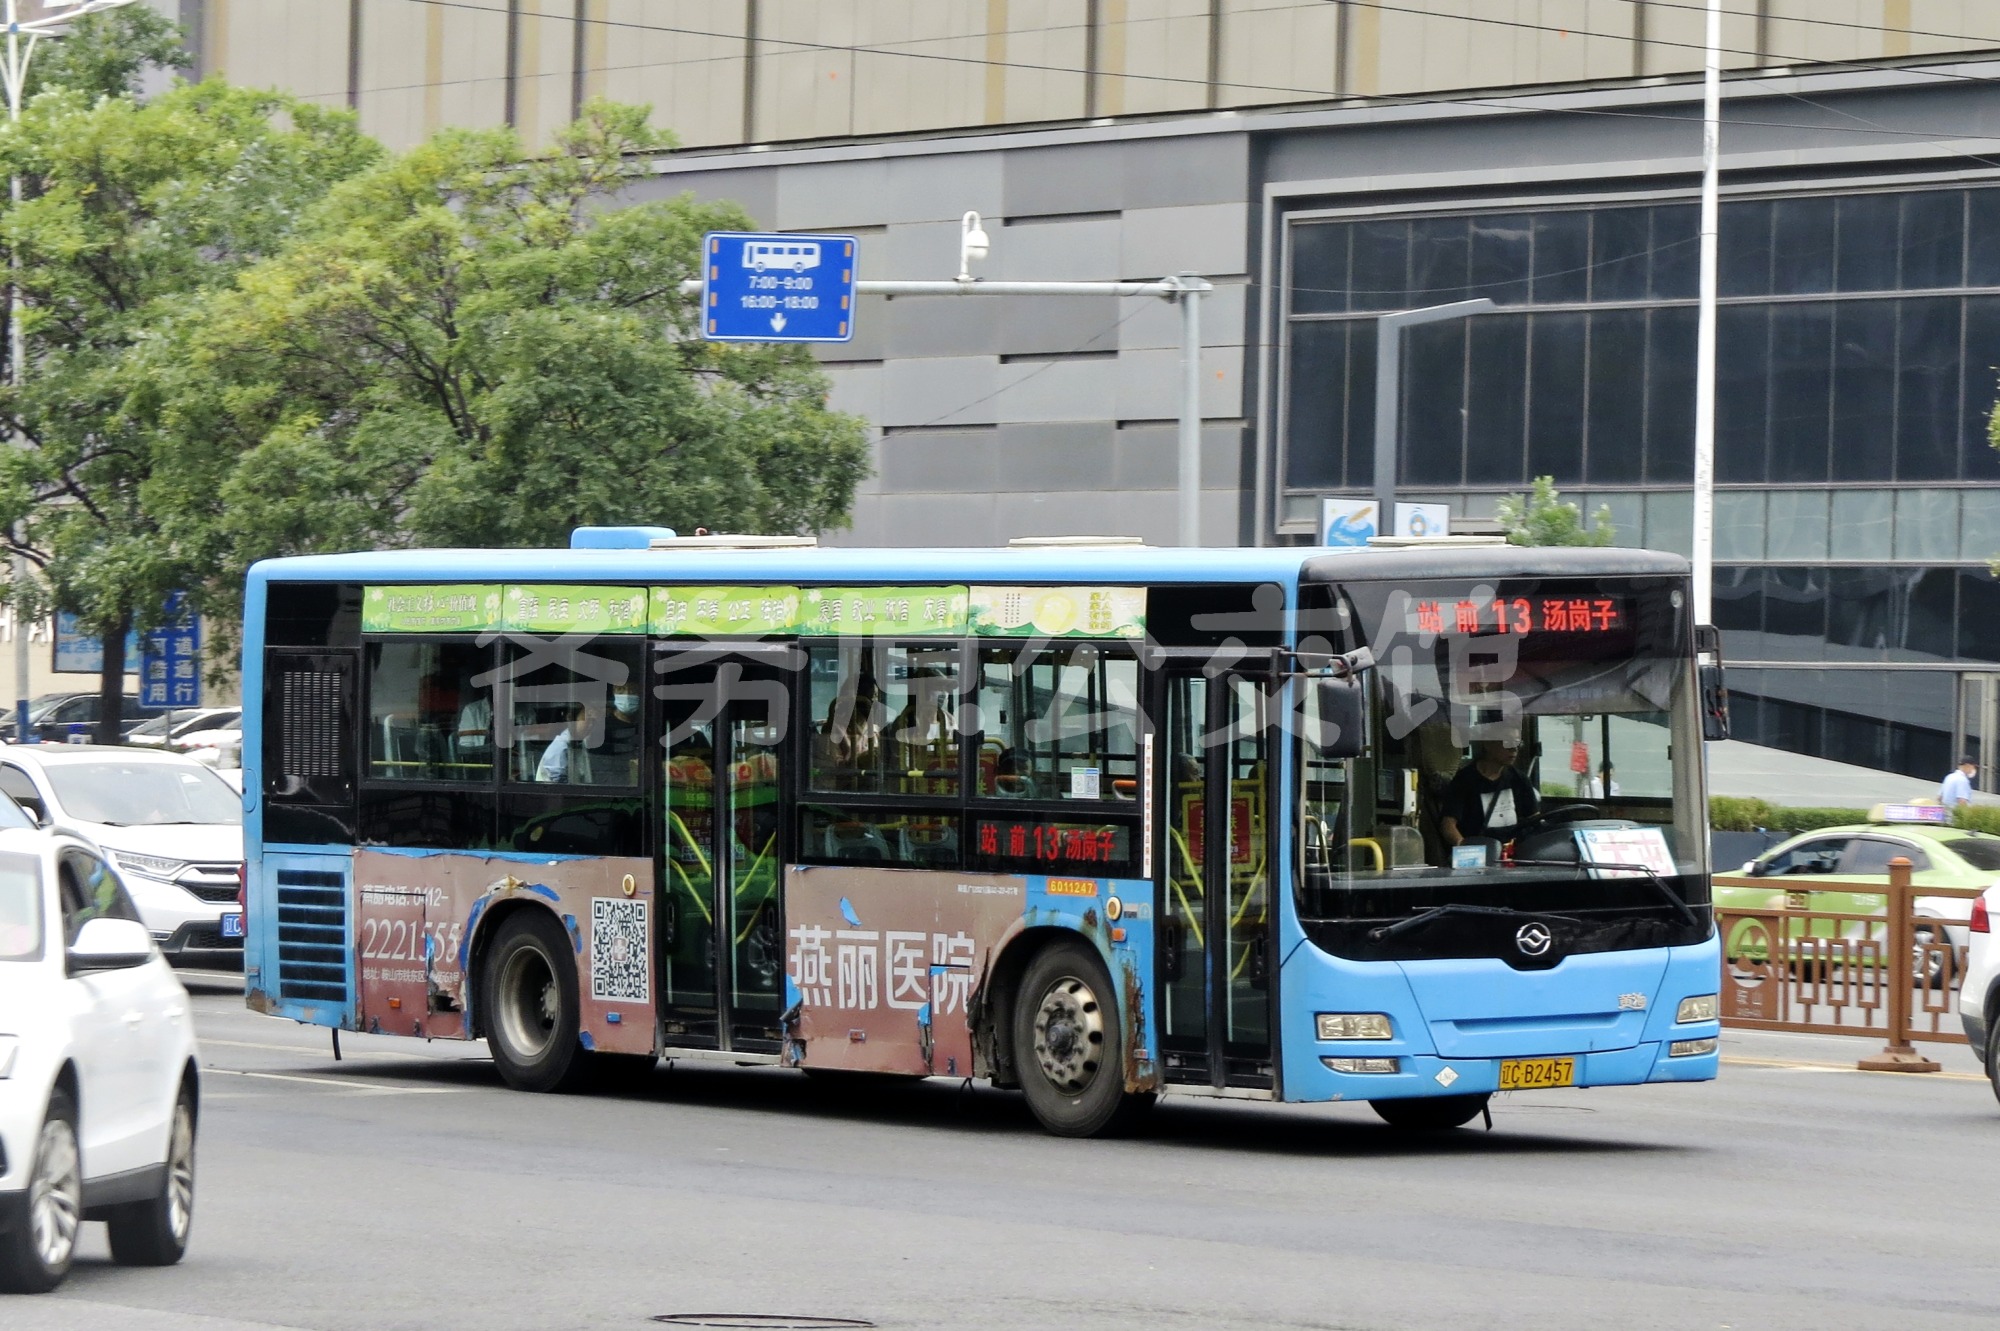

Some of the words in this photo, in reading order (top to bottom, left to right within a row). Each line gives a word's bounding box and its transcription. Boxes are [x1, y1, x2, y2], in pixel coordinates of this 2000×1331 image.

[748, 275, 814, 291] 7:00-9:00
[740, 295, 820, 310] 16:00-18:00
[1492, 597, 1534, 635] 13
[1542, 598, 1618, 633] 汤岗子
[1033, 824, 1060, 861] 13
[1063, 828, 1116, 862] 汤岗子
[1049, 880, 1094, 895] 6011247
[362, 918, 461, 963] 2221555
[789, 924, 975, 1015] 燕丽医院
